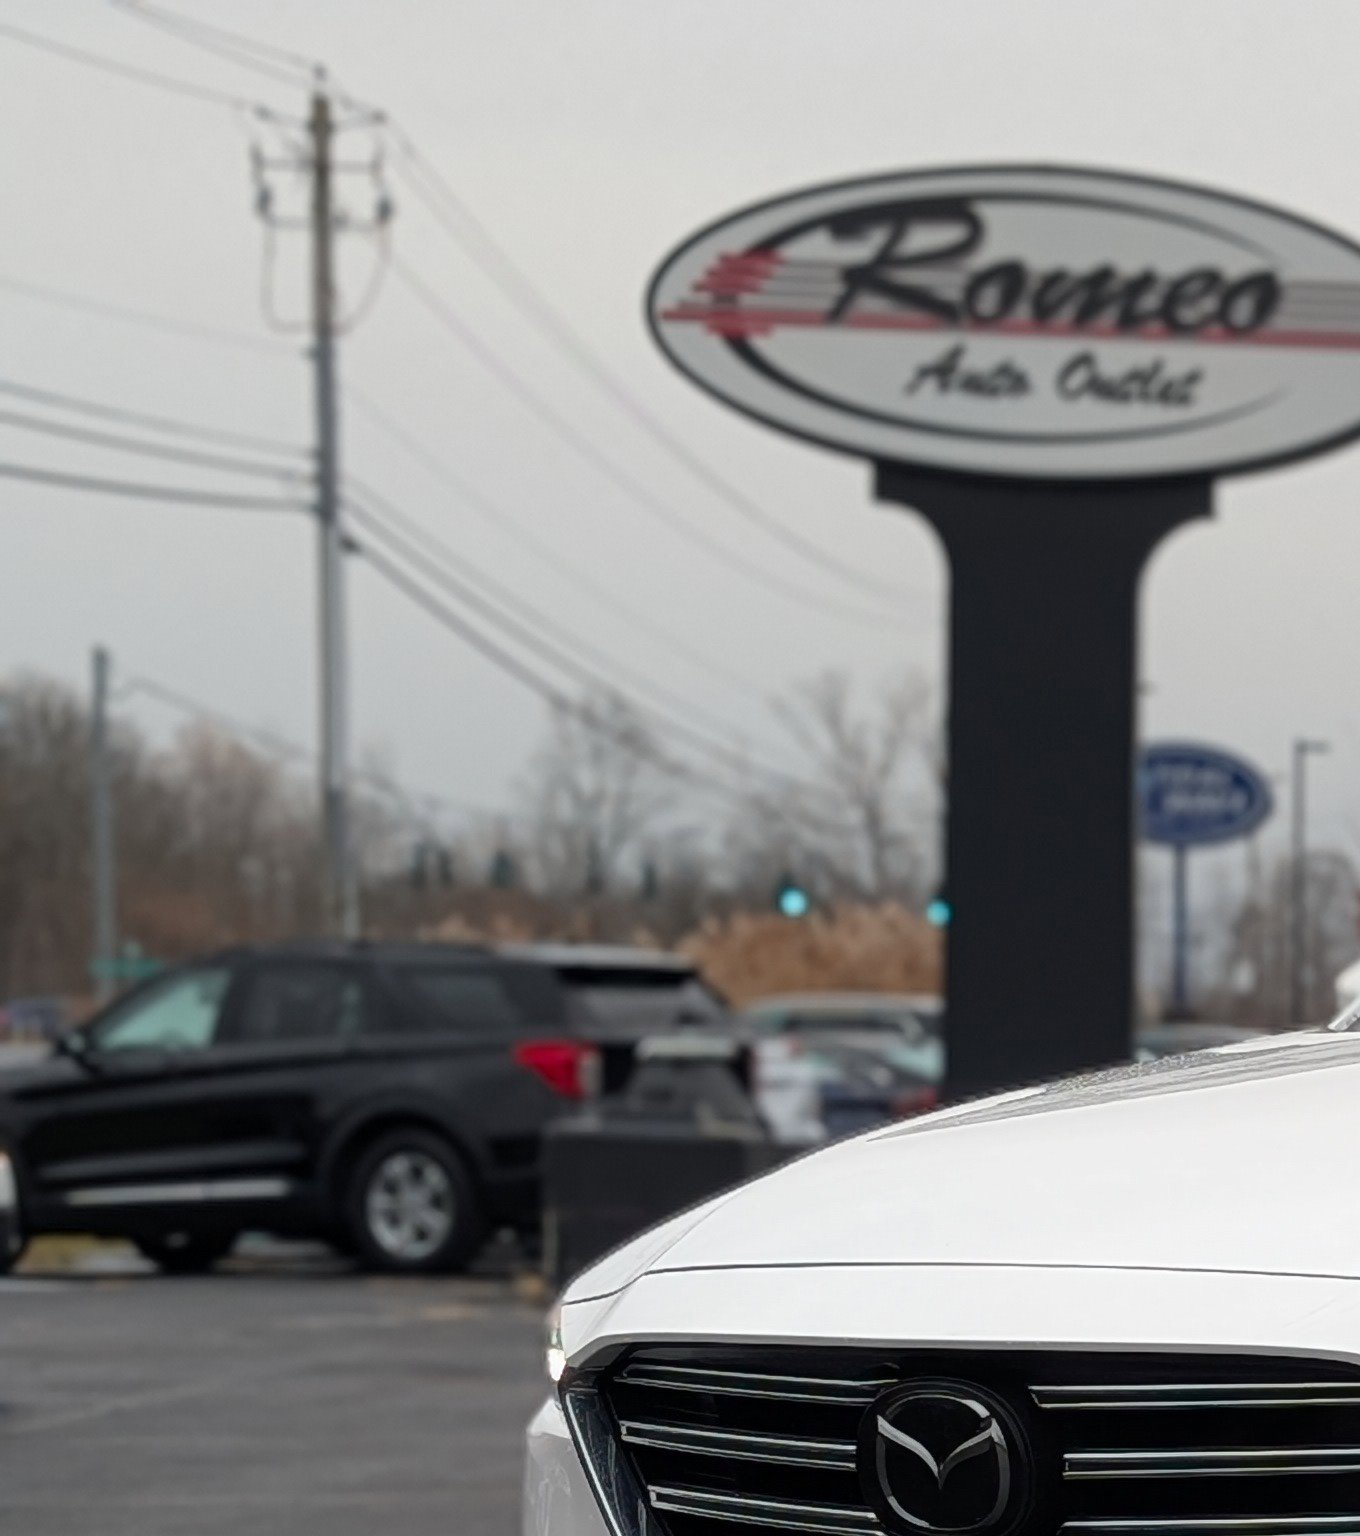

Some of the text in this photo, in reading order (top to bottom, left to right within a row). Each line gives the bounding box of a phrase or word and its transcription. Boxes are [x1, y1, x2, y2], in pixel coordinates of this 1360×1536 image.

[822, 197, 1284, 337] Romeo
[903, 345, 1206, 408] Auto Outlet
